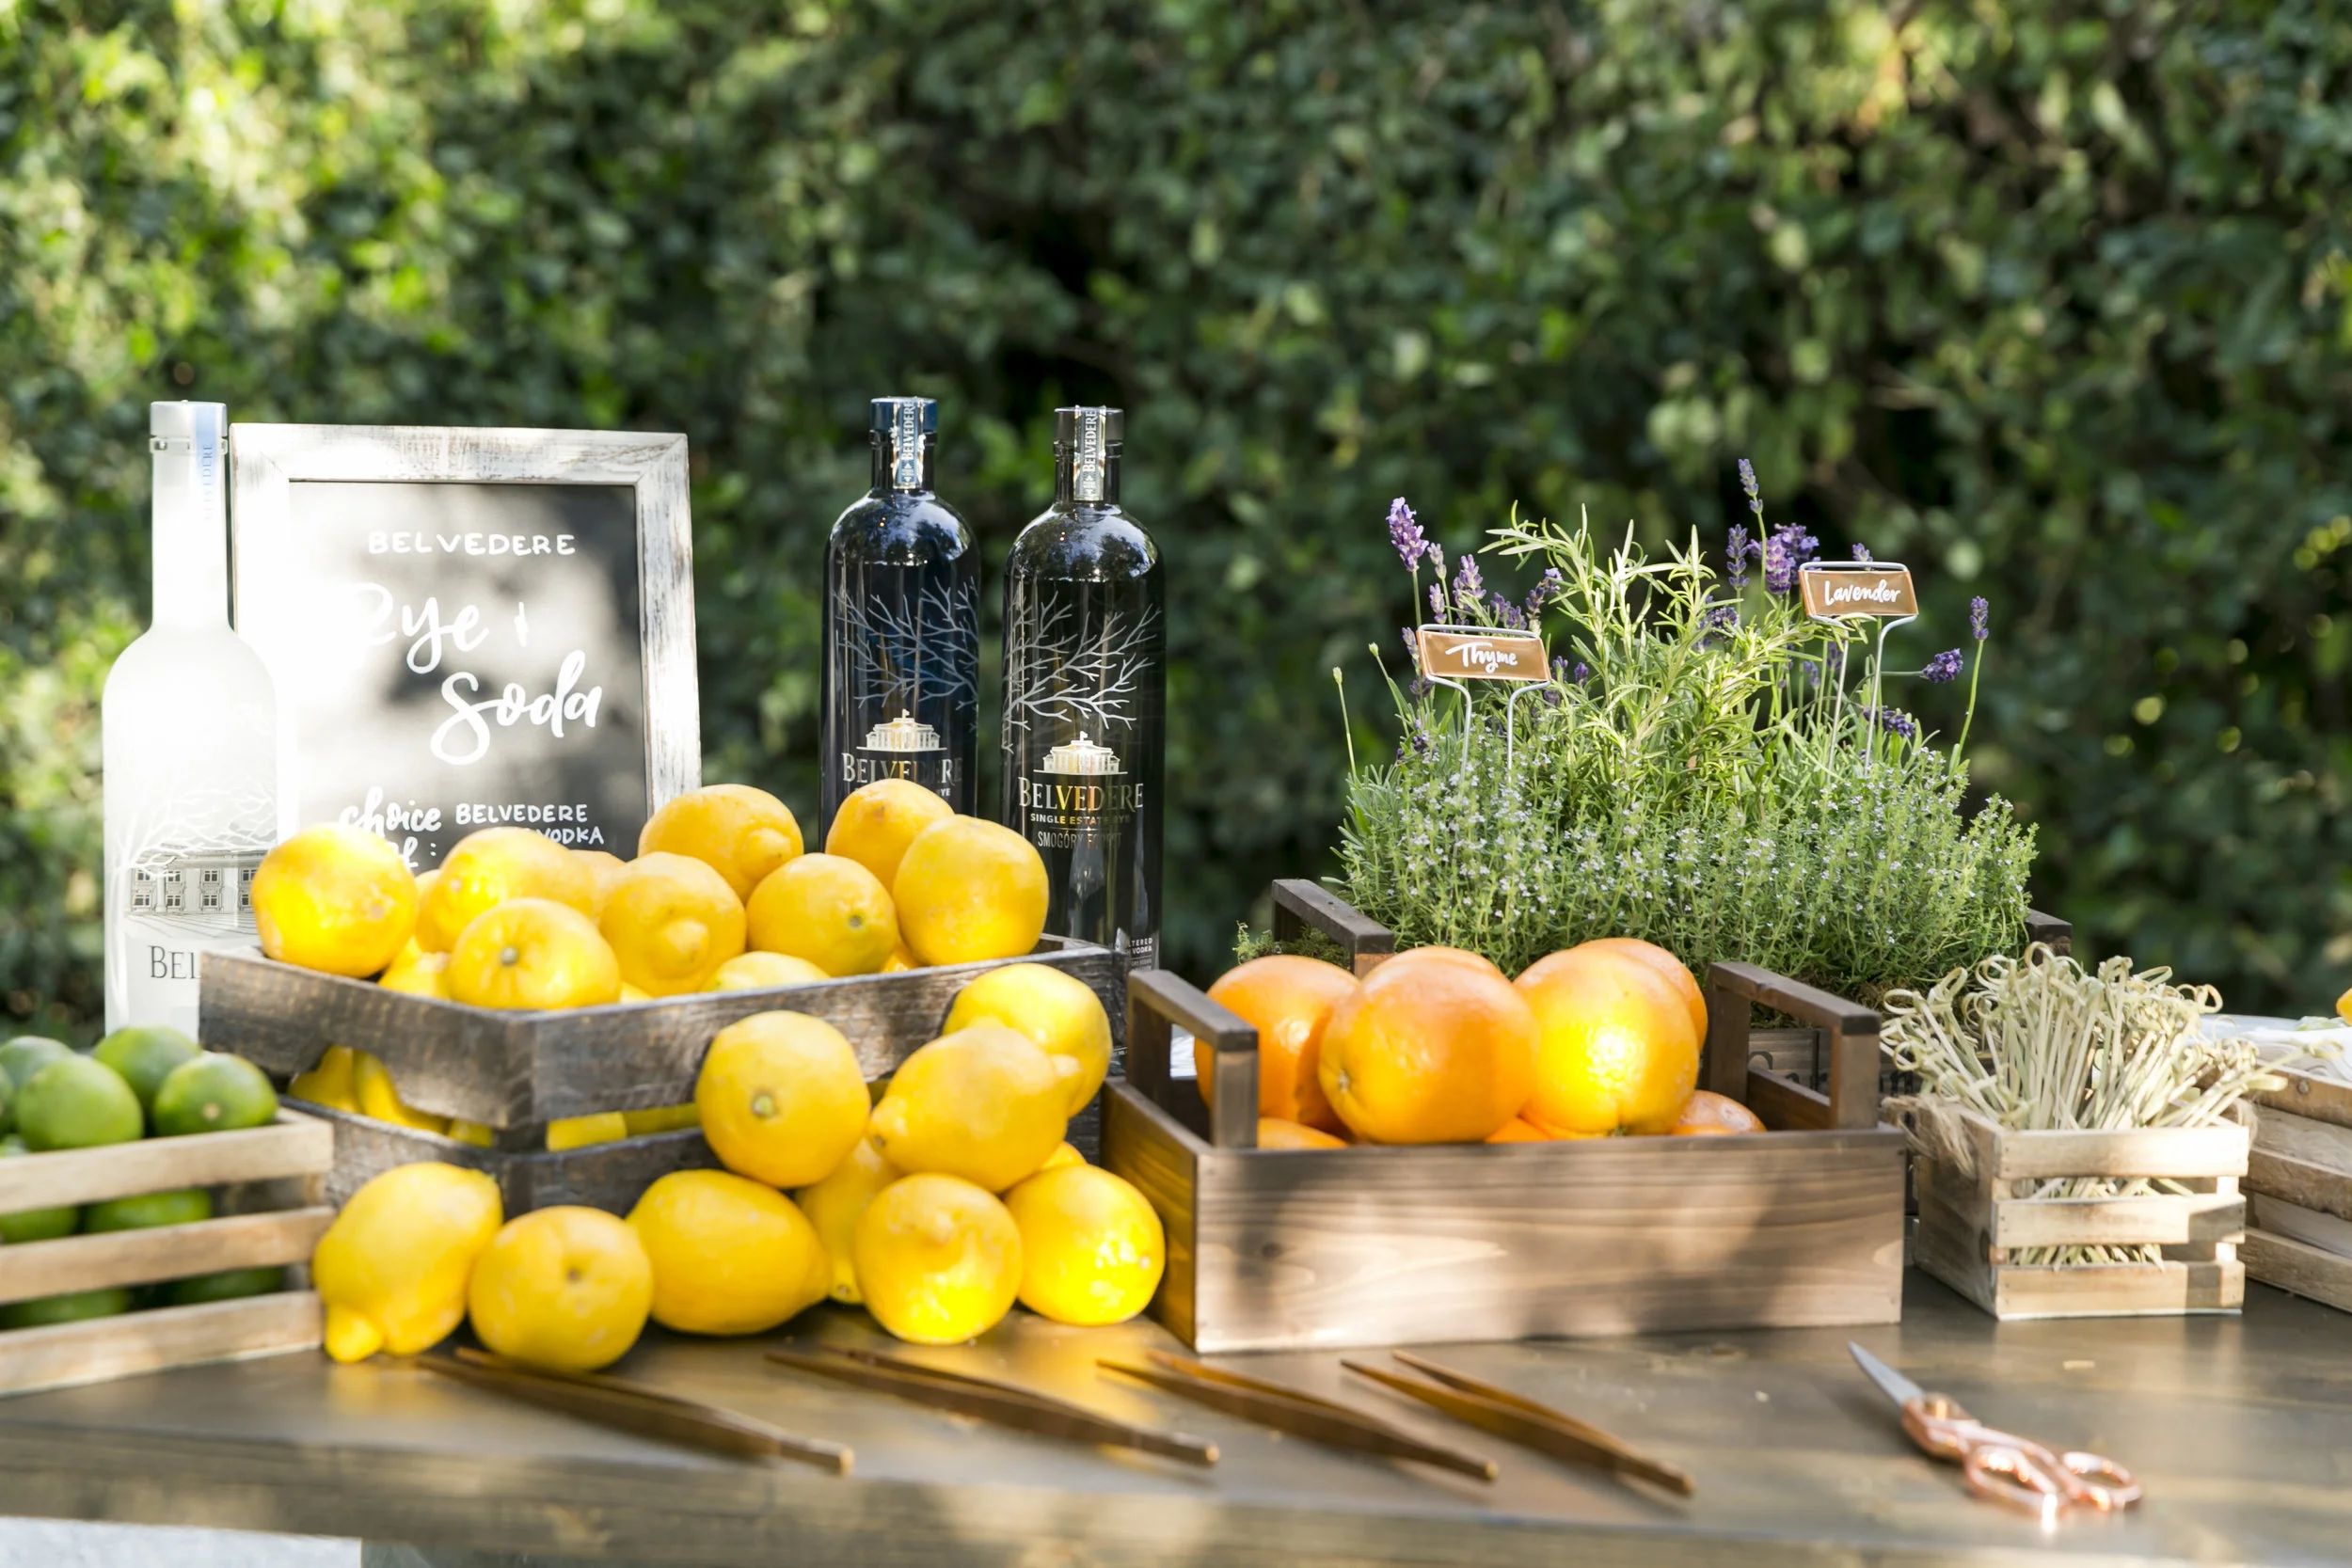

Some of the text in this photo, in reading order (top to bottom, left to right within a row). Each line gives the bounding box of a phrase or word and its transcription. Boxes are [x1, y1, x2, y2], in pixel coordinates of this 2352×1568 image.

[1082, 409, 1099, 472] BELVEDERE
[367, 531, 577, 557] BELVEDERE
[1823, 578, 1901, 607] Lavender
[1444, 641, 1518, 674] Thyme
[429, 649, 603, 766] Soda
[841, 752, 963, 786] BELVEDRE
[1017, 776, 1145, 813] BELVEDERE
[338, 785, 589, 839] choice BELVEDERE
[1030, 813, 1067, 825] SINGLE
[536, 826, 605, 846] VODKA
